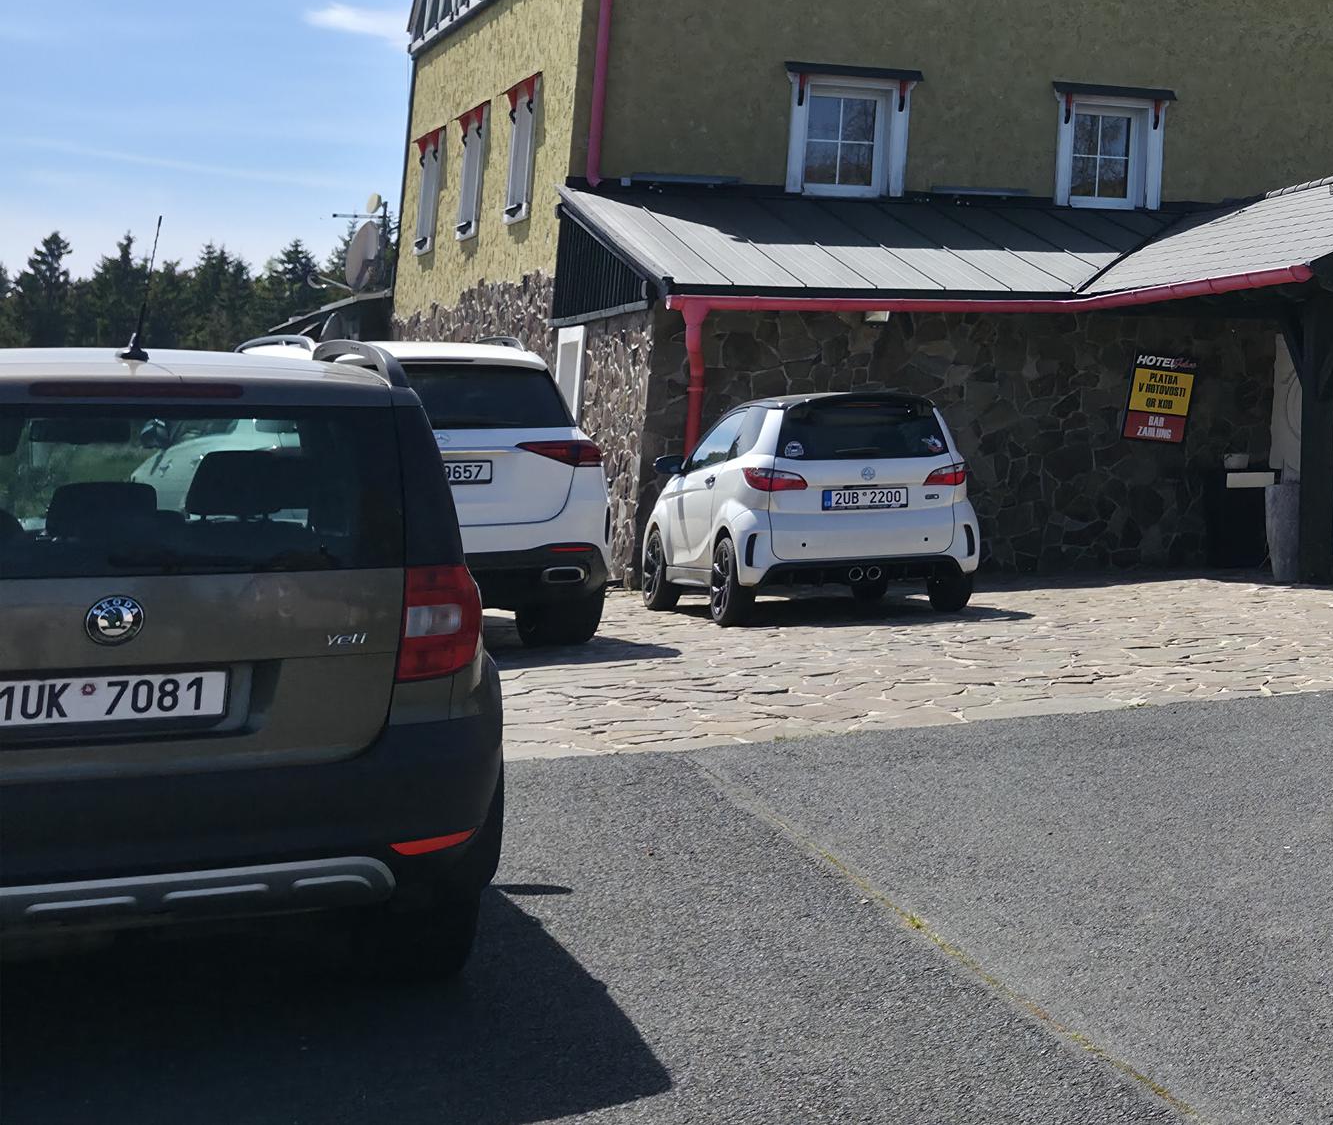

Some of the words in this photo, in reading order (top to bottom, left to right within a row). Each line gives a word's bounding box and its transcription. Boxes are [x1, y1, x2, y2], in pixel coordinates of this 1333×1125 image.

[1136, 354, 1176, 368] HOTEL
[1149, 372, 1178, 385] PLATBA
[1138, 382, 1145, 393] V
[1146, 398, 1156, 408] QR
[835, 491, 859, 505] 2UB
[869, 490, 902, 504] 2200
[0, 682, 71, 721] 1UK
[104, 677, 204, 716] 7081
